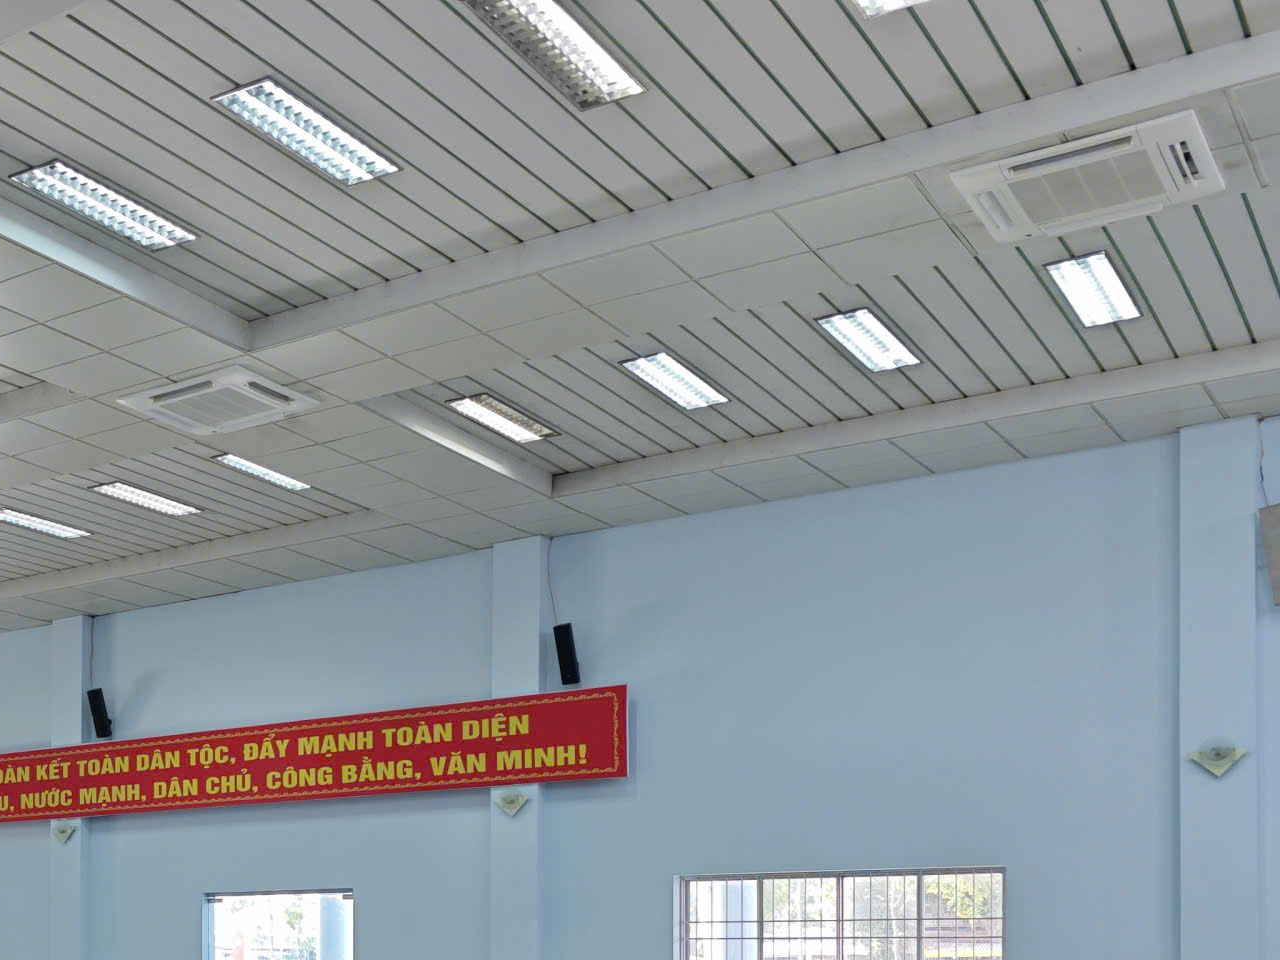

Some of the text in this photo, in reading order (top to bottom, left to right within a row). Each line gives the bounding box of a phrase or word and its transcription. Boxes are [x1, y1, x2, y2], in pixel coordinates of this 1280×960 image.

[21, 787, 72, 809] NƯỚC
[79, 783, 147, 807] MẠNH,
[153, 776, 199, 799] DÂN
[205, 768, 258, 795] CHỦ,
[266, 766, 333, 790] CÔNG
[341, 756, 421, 784] BẰNG,
[430, 751, 487, 776] VĂN
[497, 744, 587, 772] MINH!
[36, 757, 70, 781] KẾT
[77, 755, 129, 776] TOÀN
[136, 749, 180, 771] DÂN
[187, 744, 236, 769] TỘC,
[243, 733, 290, 761] ĐẨY
[298, 730, 374, 757] MẠNH
[382, 721, 453, 747] TOÀN
[462, 713, 530, 741] DIỆN
